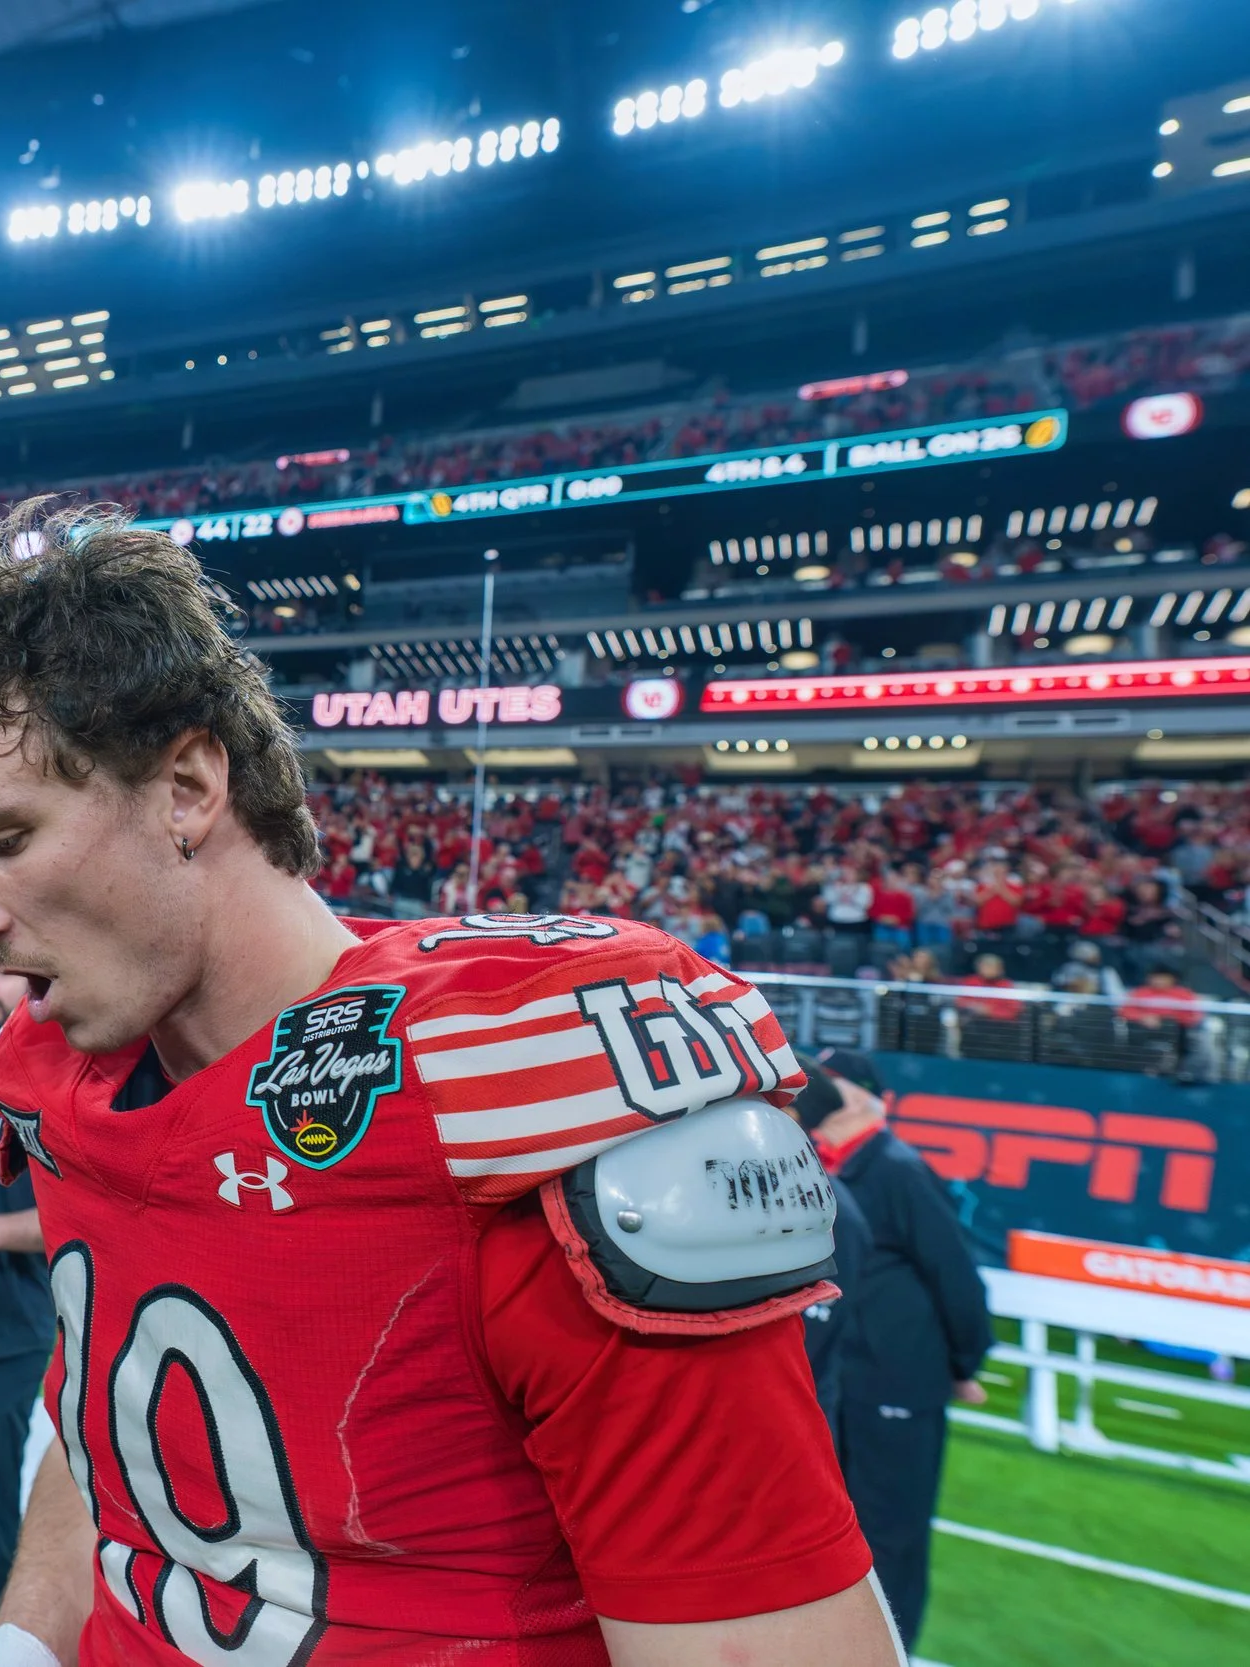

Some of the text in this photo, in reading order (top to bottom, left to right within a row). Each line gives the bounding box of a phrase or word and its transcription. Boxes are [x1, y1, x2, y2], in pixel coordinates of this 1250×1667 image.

[848, 438, 927, 468] BALL
[927, 430, 979, 457] ON
[196, 519, 230, 541] 44
[241, 514, 273, 538] 22
[312, 685, 561, 727] UTAH UTES
[302, 1023, 358, 1044] DISTRIBUTION
[305, 1000, 366, 1034] SRS
[254, 1041, 391, 1096] Las Vegas
[291, 1089, 337, 1107] BOWL
[883, 1089, 1217, 1213] SPN
